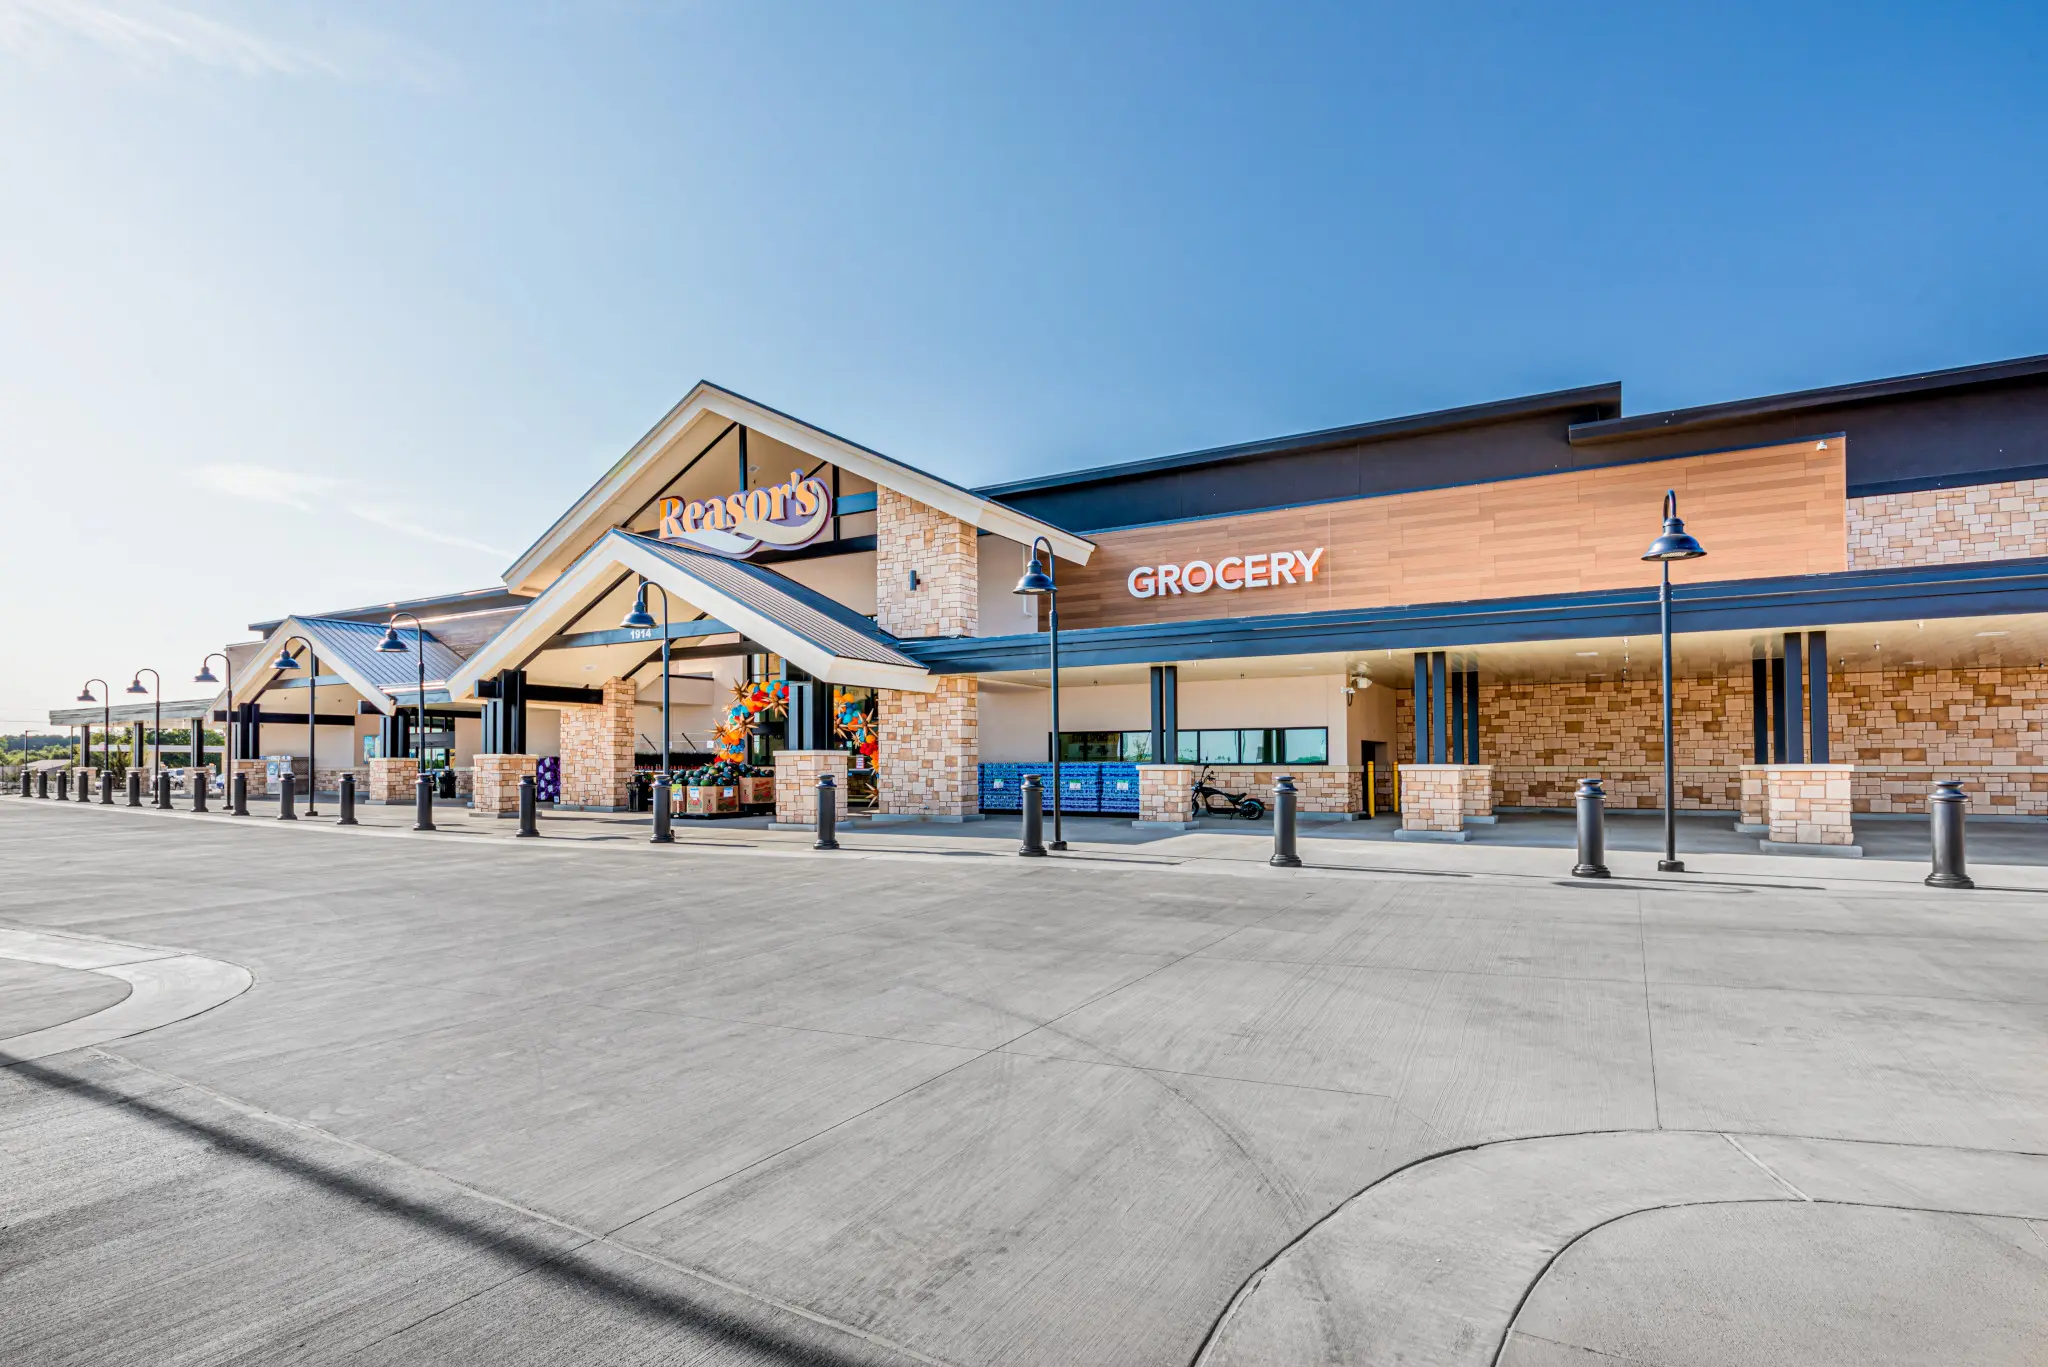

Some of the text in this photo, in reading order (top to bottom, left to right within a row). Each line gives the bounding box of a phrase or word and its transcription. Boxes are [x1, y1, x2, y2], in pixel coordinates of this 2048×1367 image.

[659, 471, 820, 540] Reasor's
[1127, 547, 1324, 598] GROCERY
[630, 628, 652, 640] 1914
